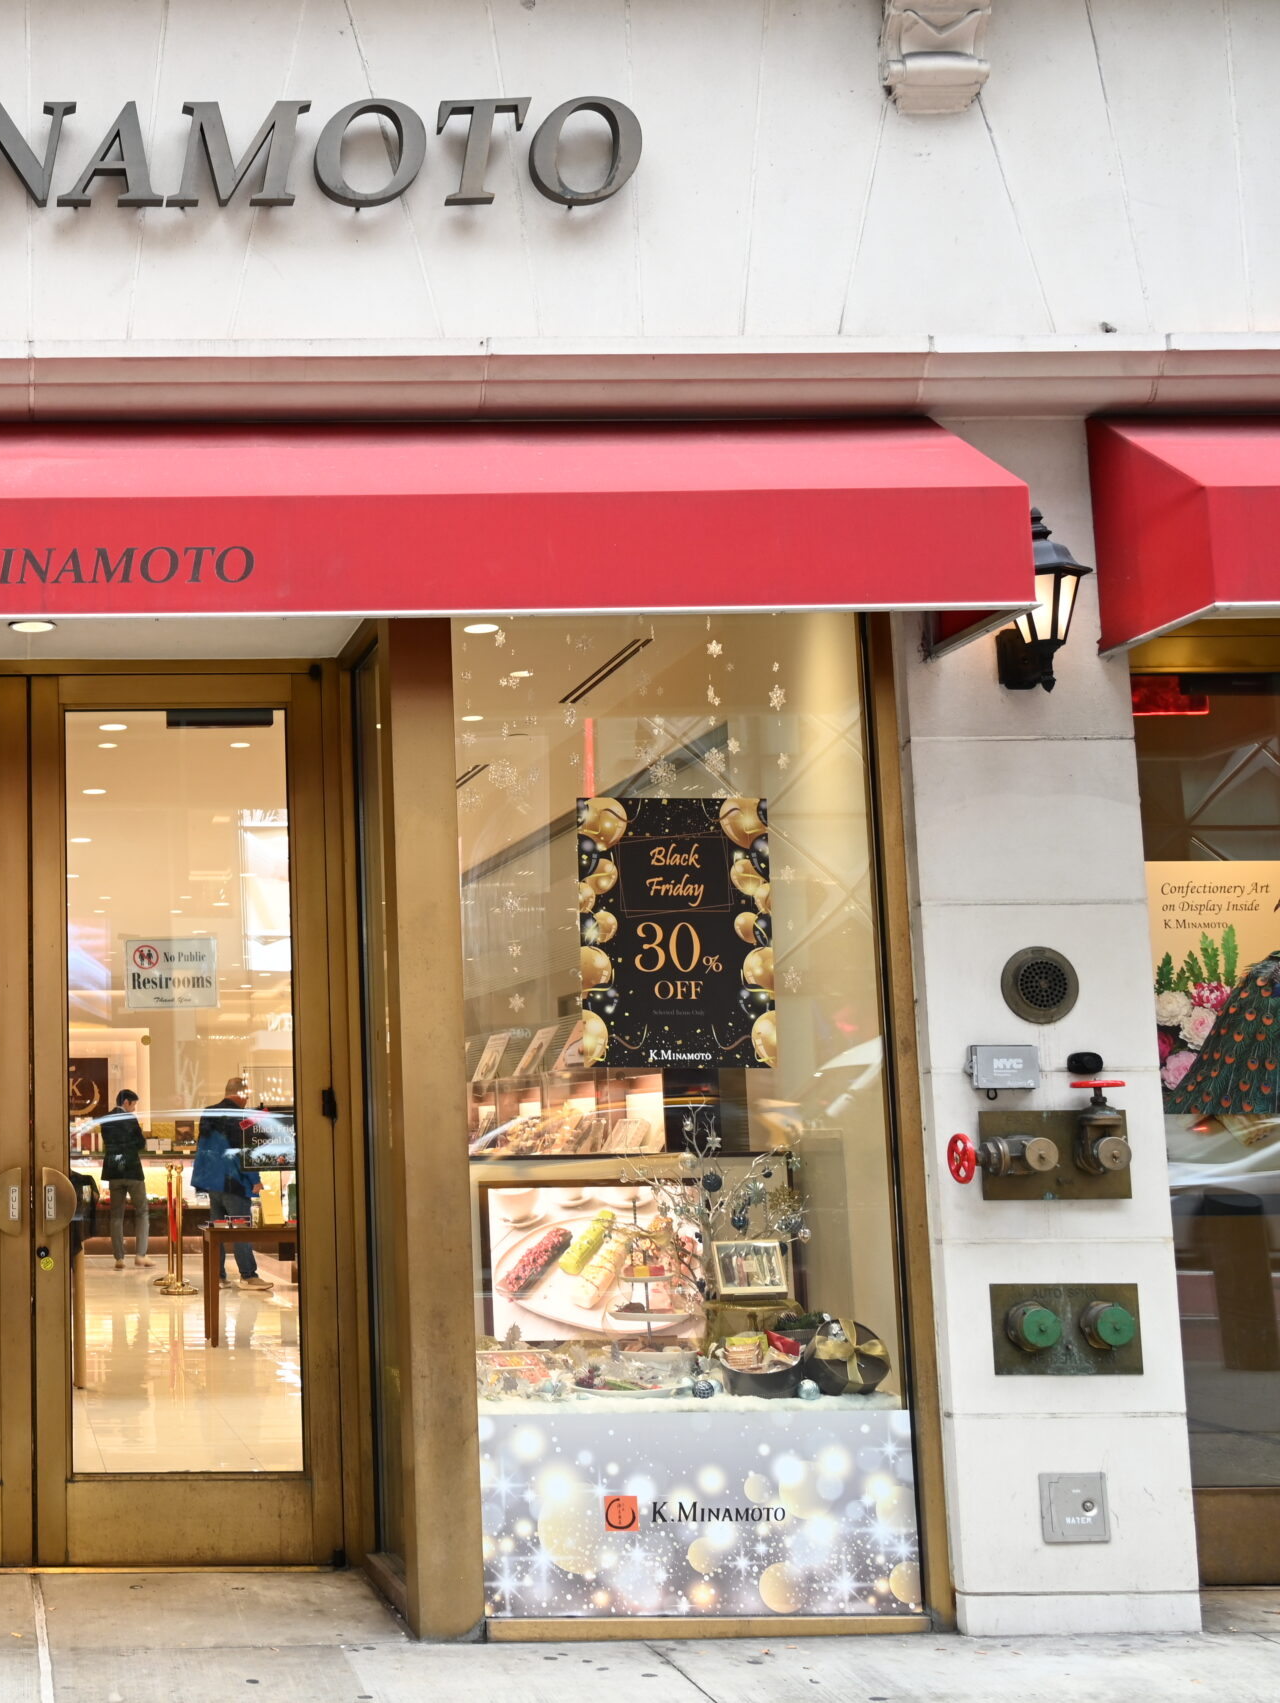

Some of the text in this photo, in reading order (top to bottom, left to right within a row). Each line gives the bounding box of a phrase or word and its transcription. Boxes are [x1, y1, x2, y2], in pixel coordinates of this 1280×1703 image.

[649, 843, 701, 869] Black
[645, 873, 705, 907] Friday
[1160, 881, 1270, 897] Confectionery Art
[1162, 900, 1260, 915] on Display Inside
[163, 951, 207, 963] No Public
[131, 972, 212, 990] Restrooms
[654, 980, 704, 1000] OFF
[993, 1058, 1023, 1069] NYC
[1065, 1516, 1093, 1524] WATER
